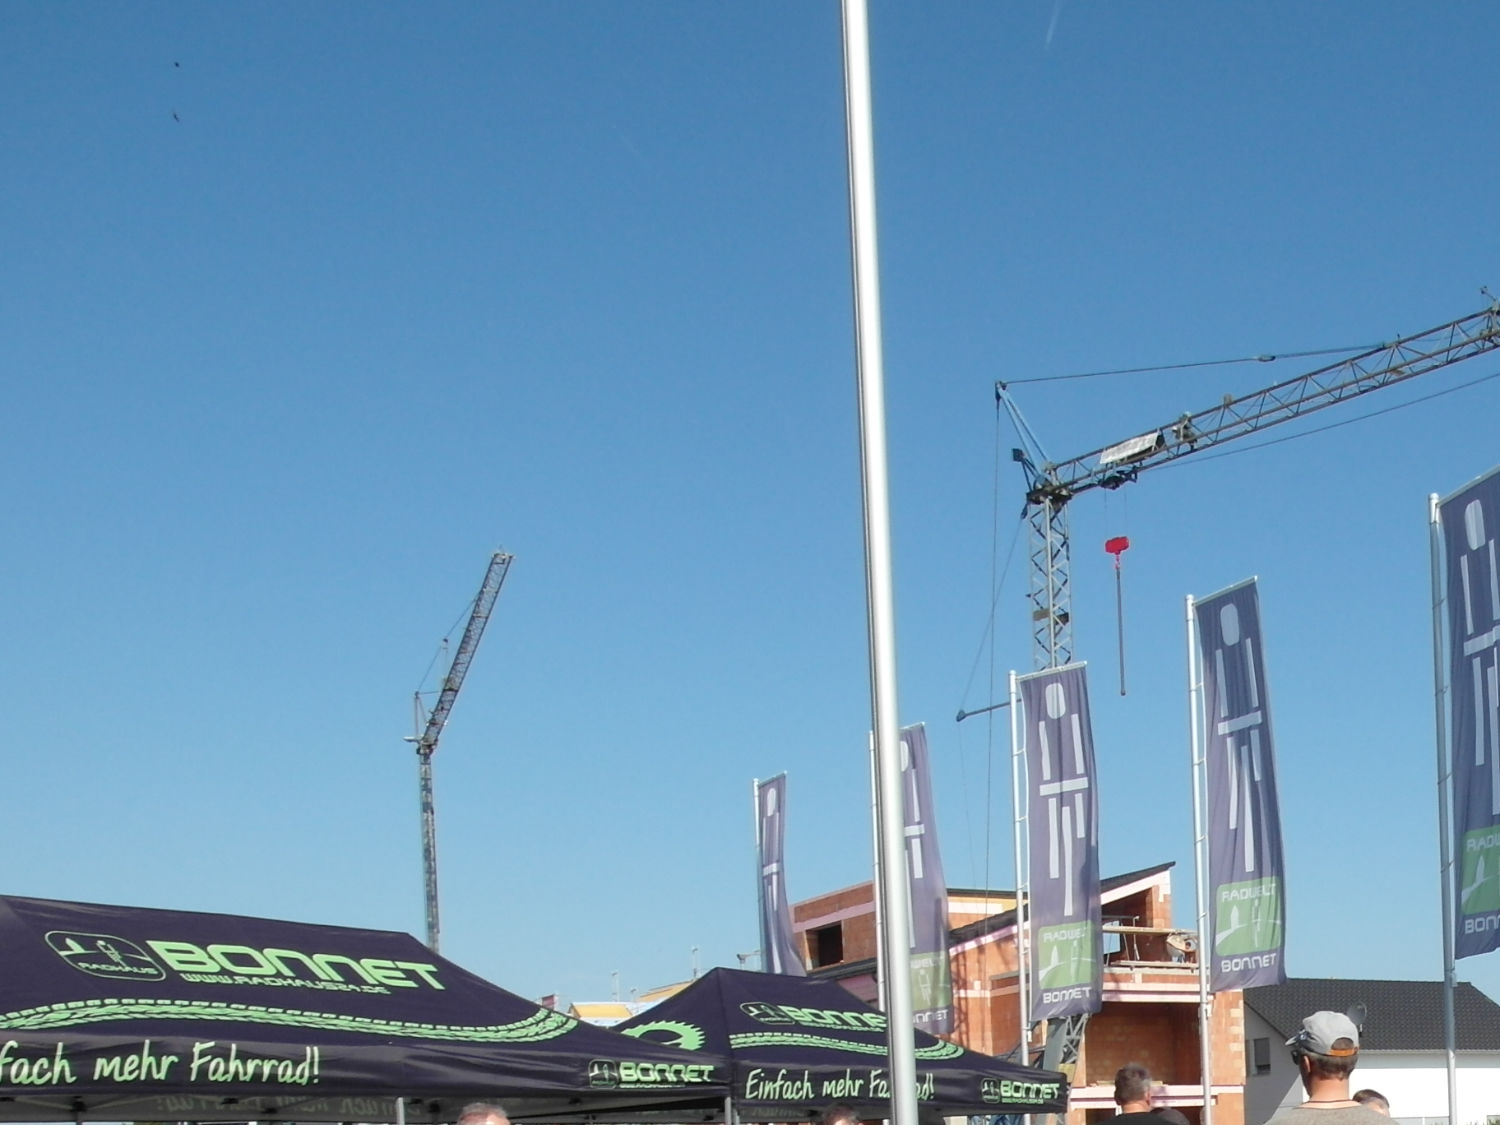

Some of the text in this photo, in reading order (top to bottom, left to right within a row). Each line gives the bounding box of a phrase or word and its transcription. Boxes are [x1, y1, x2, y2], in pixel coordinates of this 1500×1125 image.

[78, 962, 158, 975] RADHAUS
[145, 940, 446, 990] BONNET
[1221, 953, 1277, 973] BONNET
[1043, 986, 1093, 1004] BONNET
[777, 1004, 887, 1028] BONNE
[93, 1039, 179, 1082] mehr
[190, 1040, 319, 1086] Fahrrad!
[619, 1061, 714, 1083] BONNET
[745, 1068, 814, 1100] Einfach
[822, 1068, 864, 1098] mehr
[1000, 1080, 1060, 1099] BONNET
